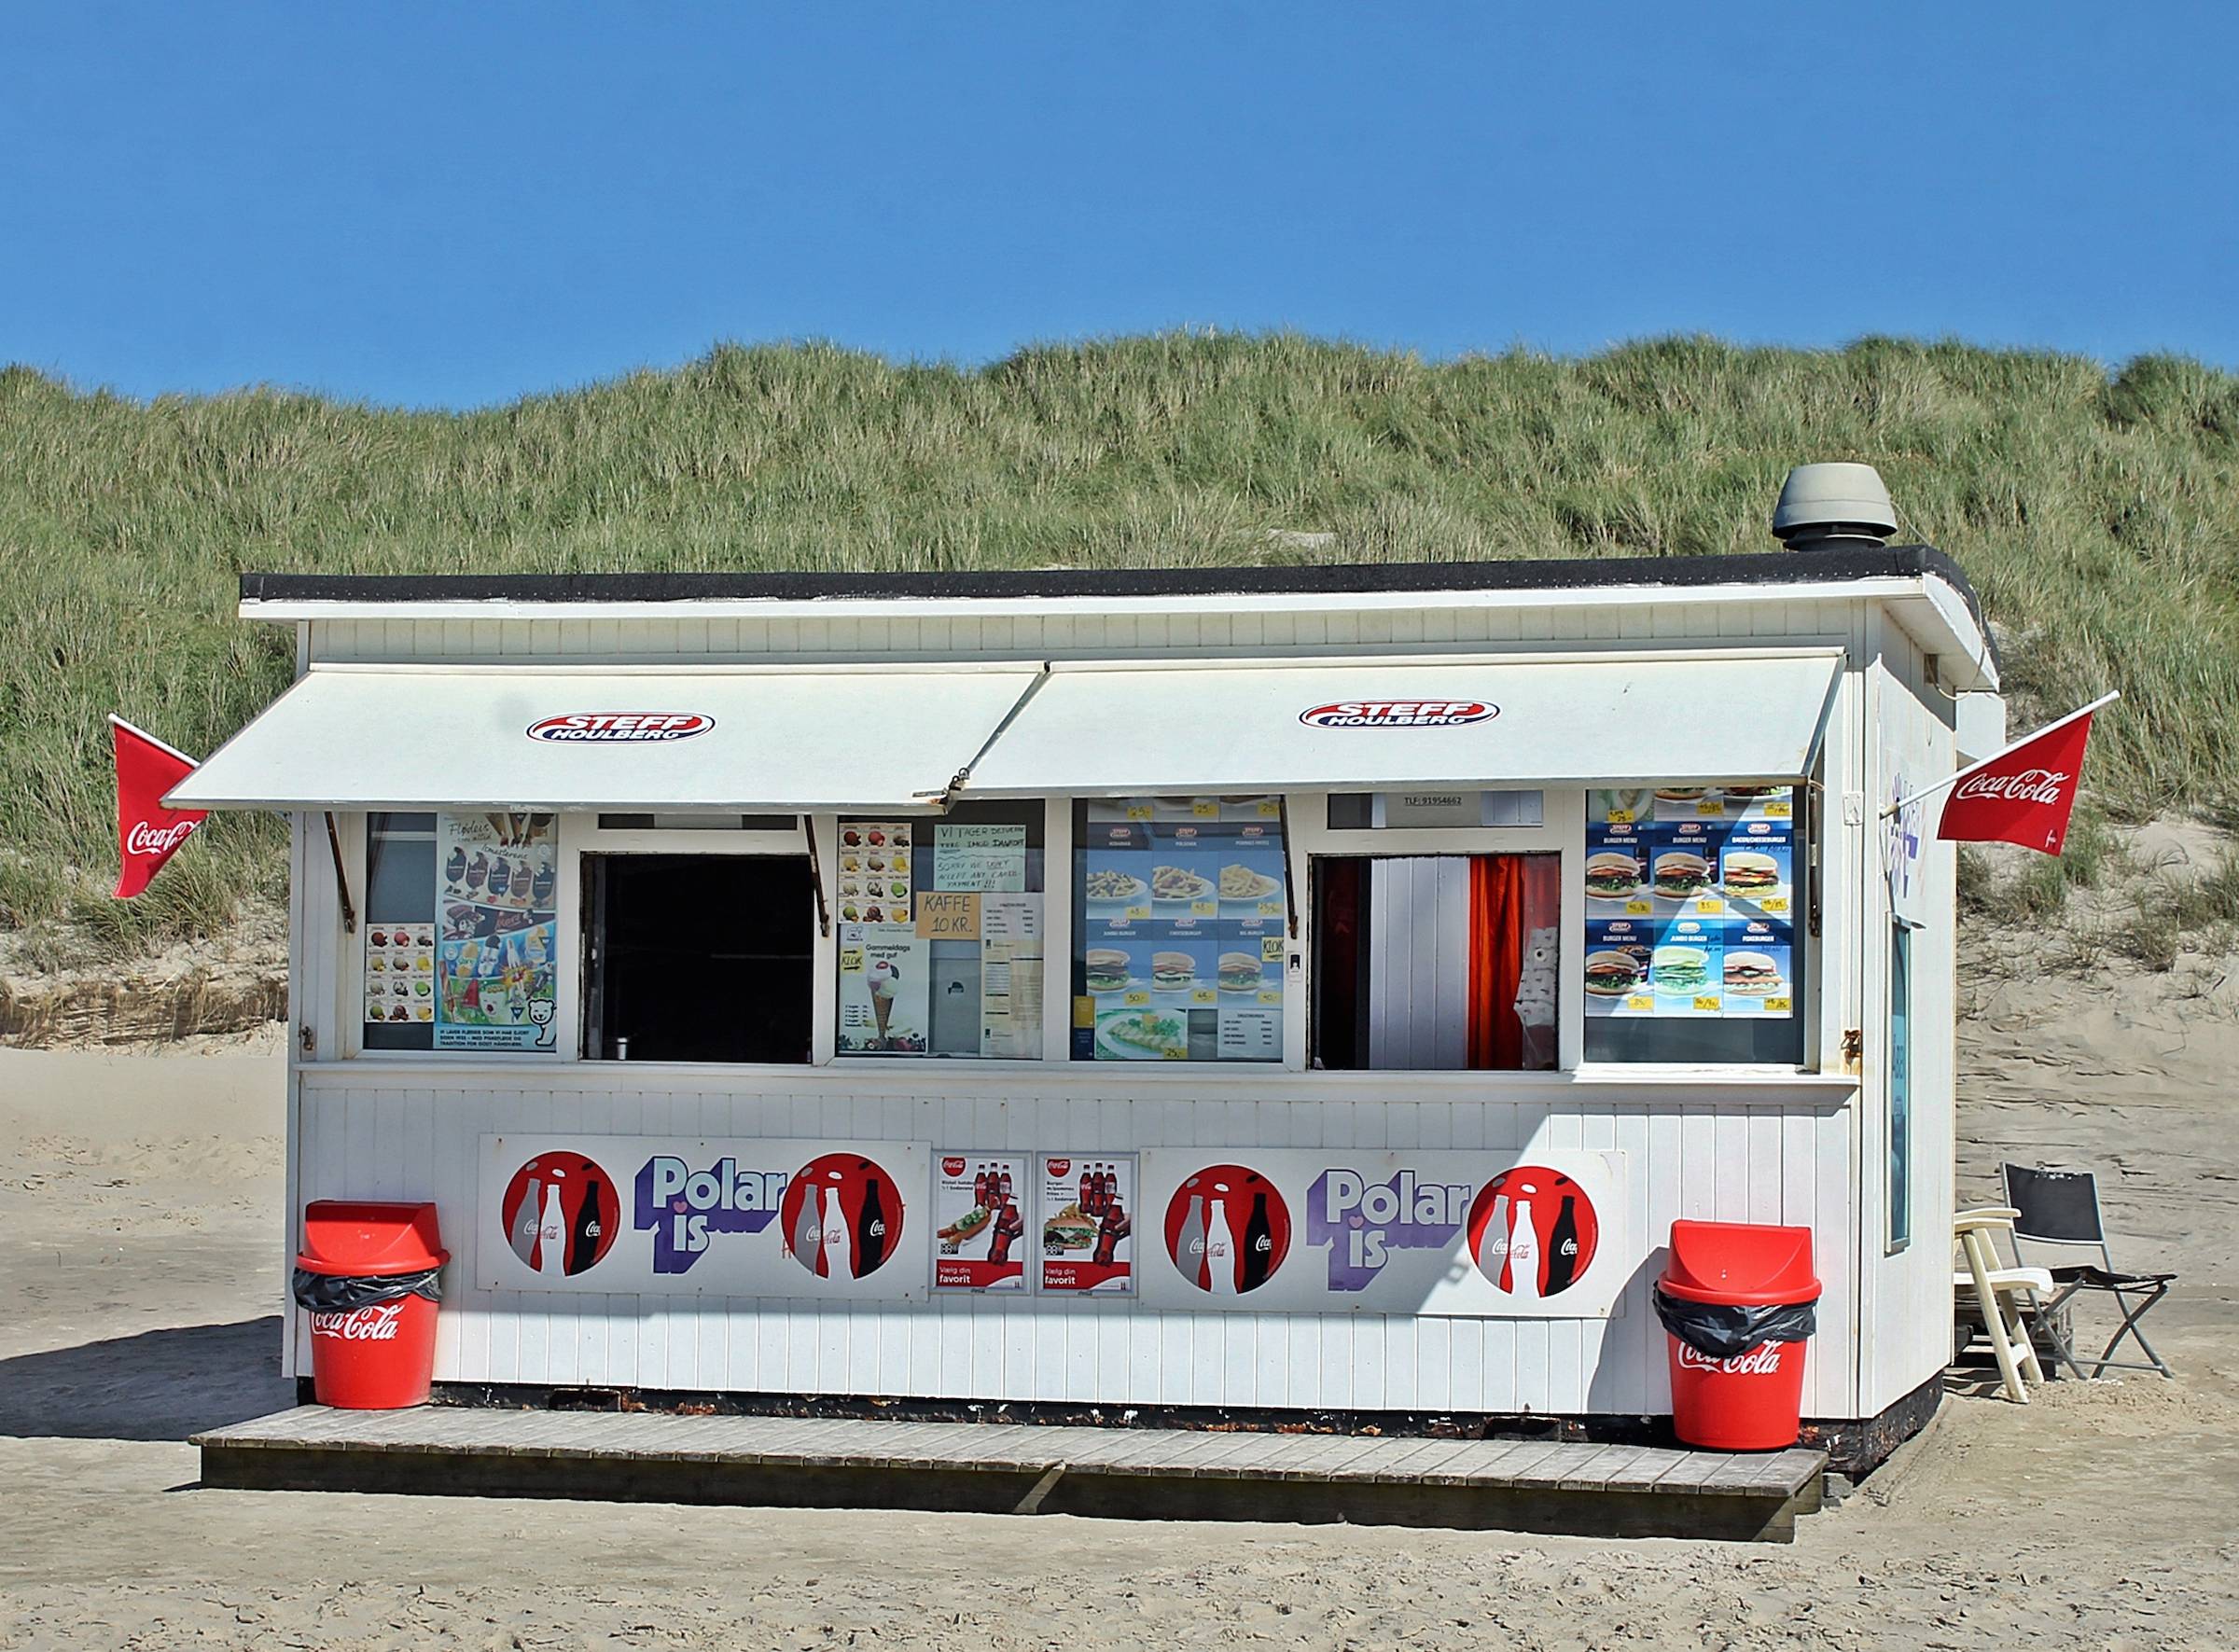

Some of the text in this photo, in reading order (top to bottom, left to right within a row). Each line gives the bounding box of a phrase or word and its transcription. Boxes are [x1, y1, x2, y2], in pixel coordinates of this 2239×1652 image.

[1336, 702, 1474, 715] STEFF
[565, 715, 694, 729] STEFF
[1327, 715, 1466, 726] HOULBERG
[550, 729, 680, 740] HOULBERG
[1956, 769, 2070, 805] Coca-Cola
[126, 820, 202, 855] Coca-C
[940, 826, 952, 838] VI
[924, 895, 971, 912] KAFFE
[931, 917, 950, 932] 10
[952, 916, 972, 933] KR.
[865, 944, 911, 952] Gammeldags
[886, 951, 897, 960] guf
[650, 1156, 788, 1213] Polar
[1325, 1168, 1472, 1226] Polar
[672, 1201, 710, 1253] is
[1348, 1215, 1390, 1269] is
[959, 1266, 971, 1275] din
[1064, 1267, 1076, 1276] din
[939, 1274, 971, 1284] favorit
[1045, 1275, 1076, 1285] favorit
